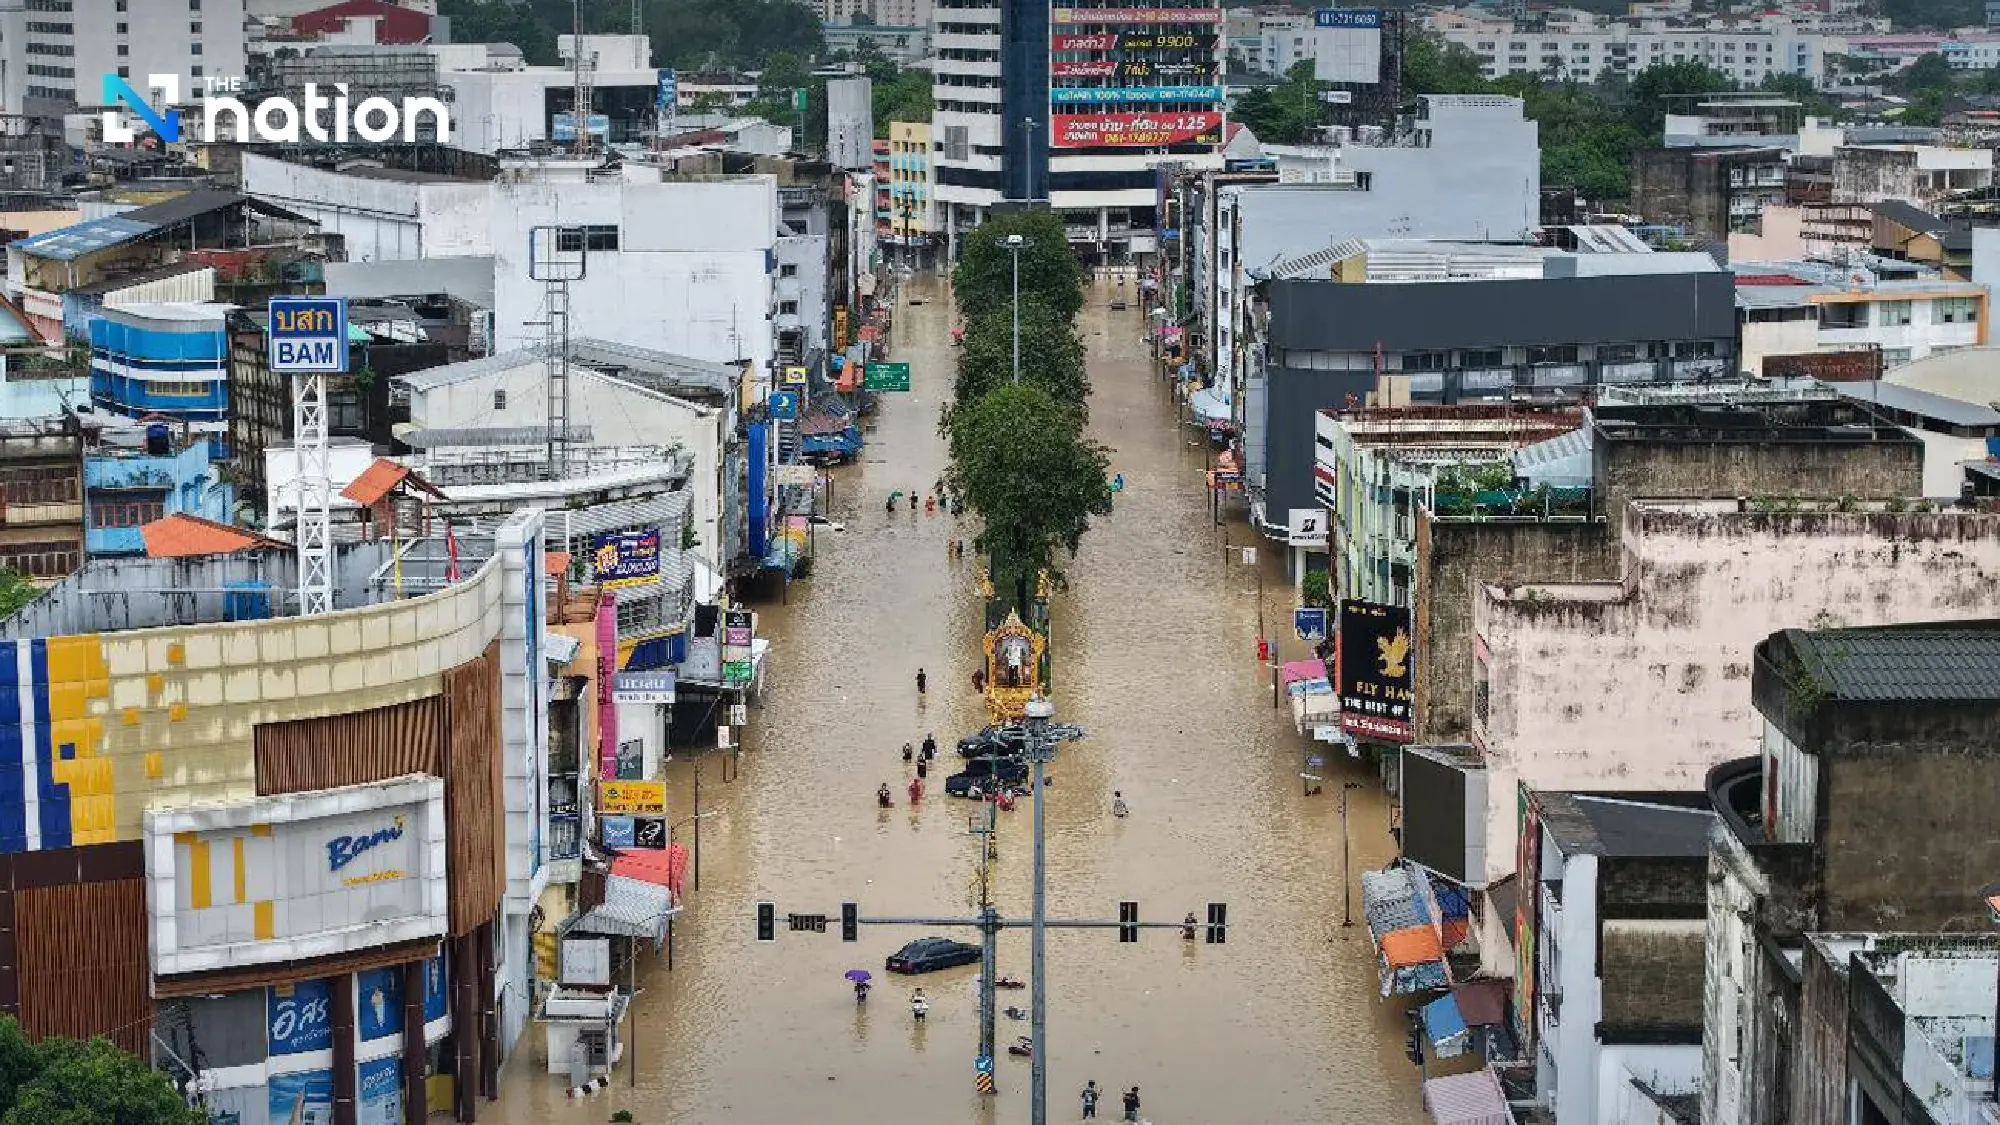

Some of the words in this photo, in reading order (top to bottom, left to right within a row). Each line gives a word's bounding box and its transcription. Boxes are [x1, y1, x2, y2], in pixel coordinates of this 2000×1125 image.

[1177, 116, 1206, 130] 1.25
[275, 308, 333, 331] บสก
[278, 342, 333, 364] BAM
[1356, 681, 1378, 696] FLY
[1344, 697, 1362, 709] THE
